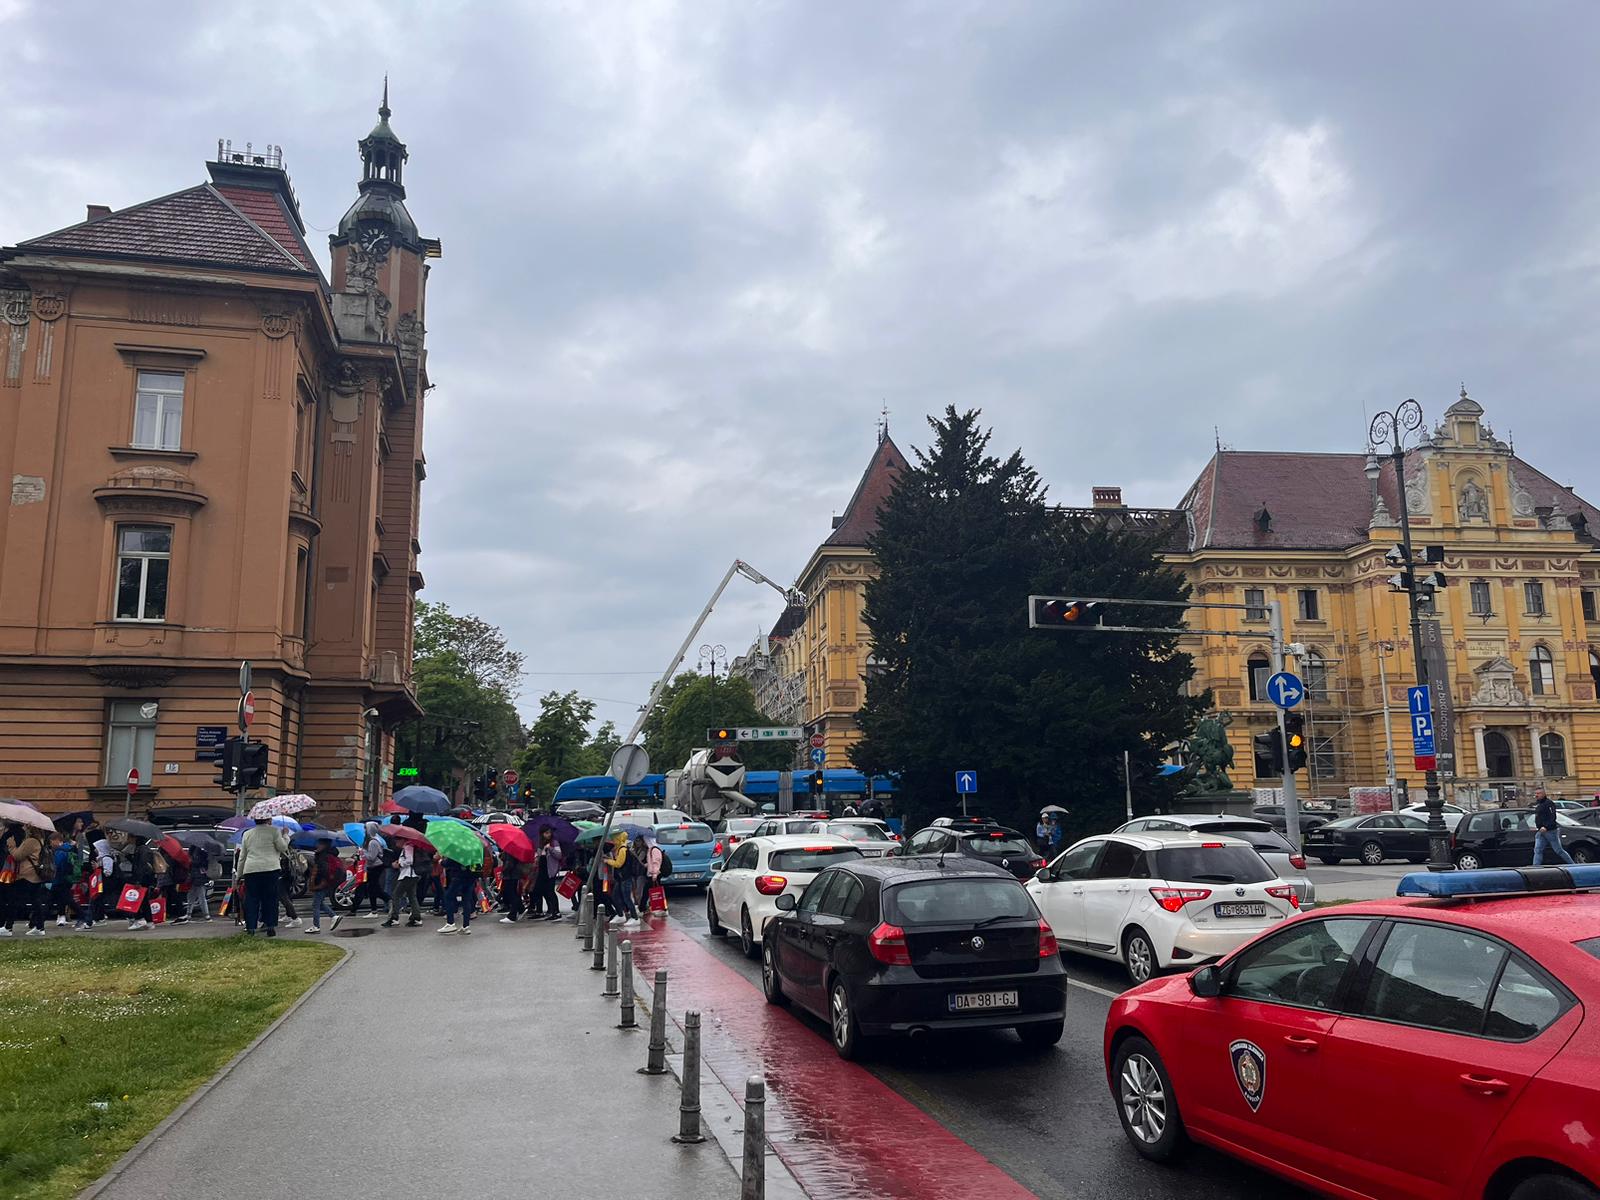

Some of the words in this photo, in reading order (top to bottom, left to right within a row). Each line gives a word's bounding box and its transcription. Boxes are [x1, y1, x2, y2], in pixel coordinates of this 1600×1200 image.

[1428, 623, 1437, 642] MUO
[1416, 716, 1427, 737] P
[1222, 905, 1232, 915] ZG
[956, 995, 970, 1008] DA
[977, 992, 1017, 1007] 981-GJ
